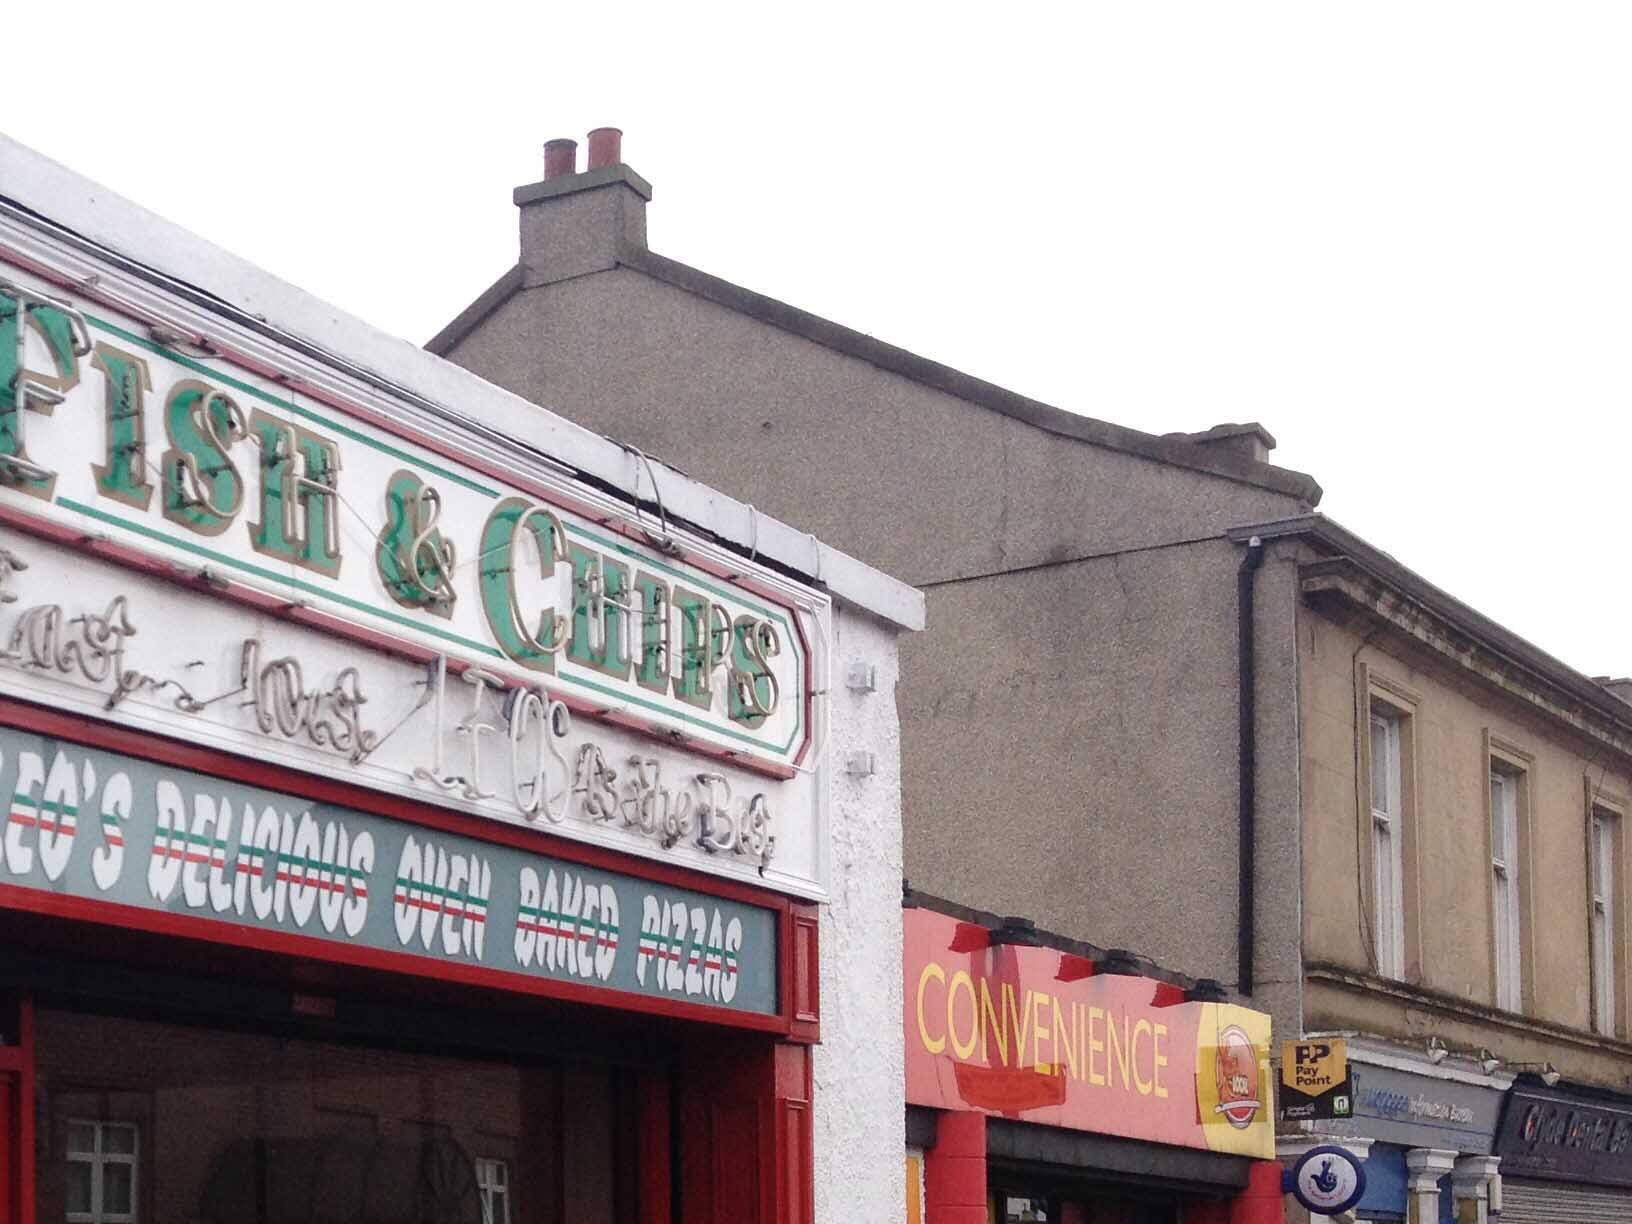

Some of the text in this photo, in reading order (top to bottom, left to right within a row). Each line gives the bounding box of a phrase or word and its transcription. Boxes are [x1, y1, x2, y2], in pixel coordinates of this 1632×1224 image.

[480, 496, 780, 730] CHIPS
[146, 780, 375, 937] DELICIOUS
[393, 834, 492, 961] OVEN
[513, 866, 621, 982] BAKED
[635, 895, 743, 1004] PIZZAS
[917, 962, 1169, 1098] CONVENIENCE
[1295, 1065, 1319, 1080] Pay
[1295, 1075, 1331, 1087] Point
